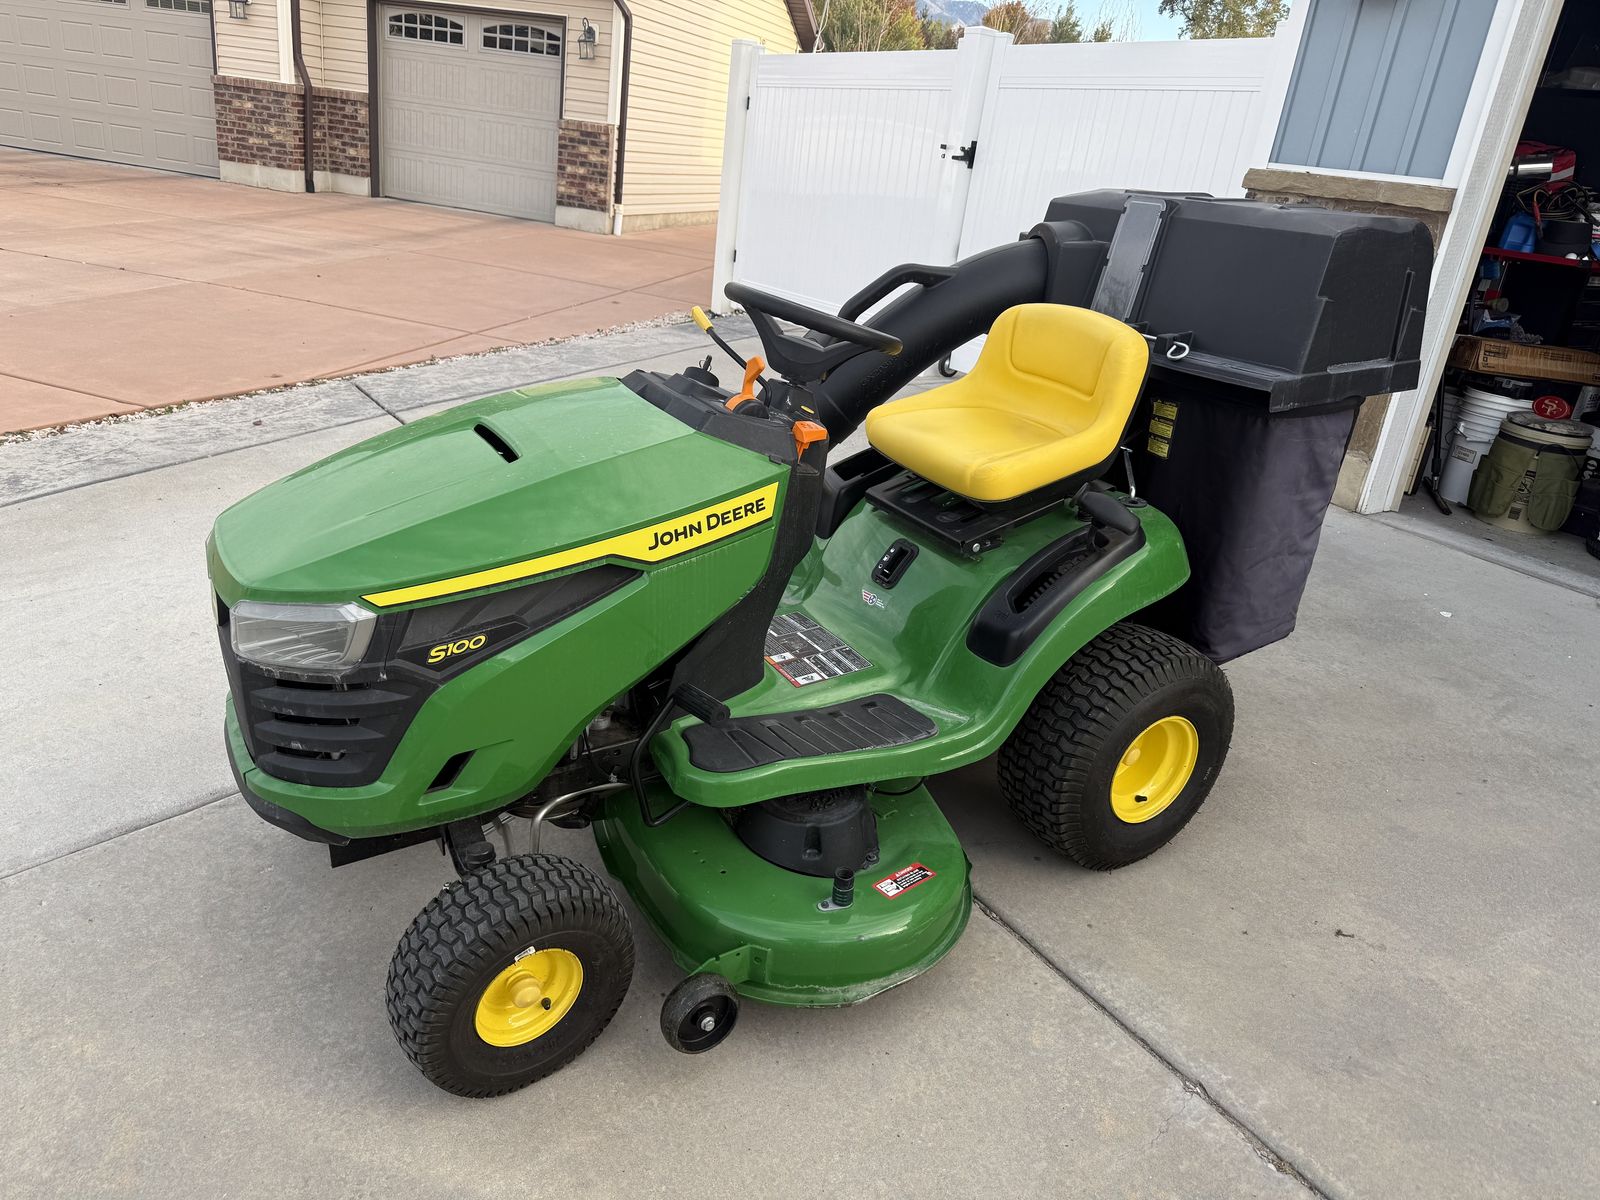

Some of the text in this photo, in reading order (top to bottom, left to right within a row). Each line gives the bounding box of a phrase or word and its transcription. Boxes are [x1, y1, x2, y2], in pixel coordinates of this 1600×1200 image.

[648, 498, 766, 551] JOHN DEERE
[427, 634, 486, 663] S100
